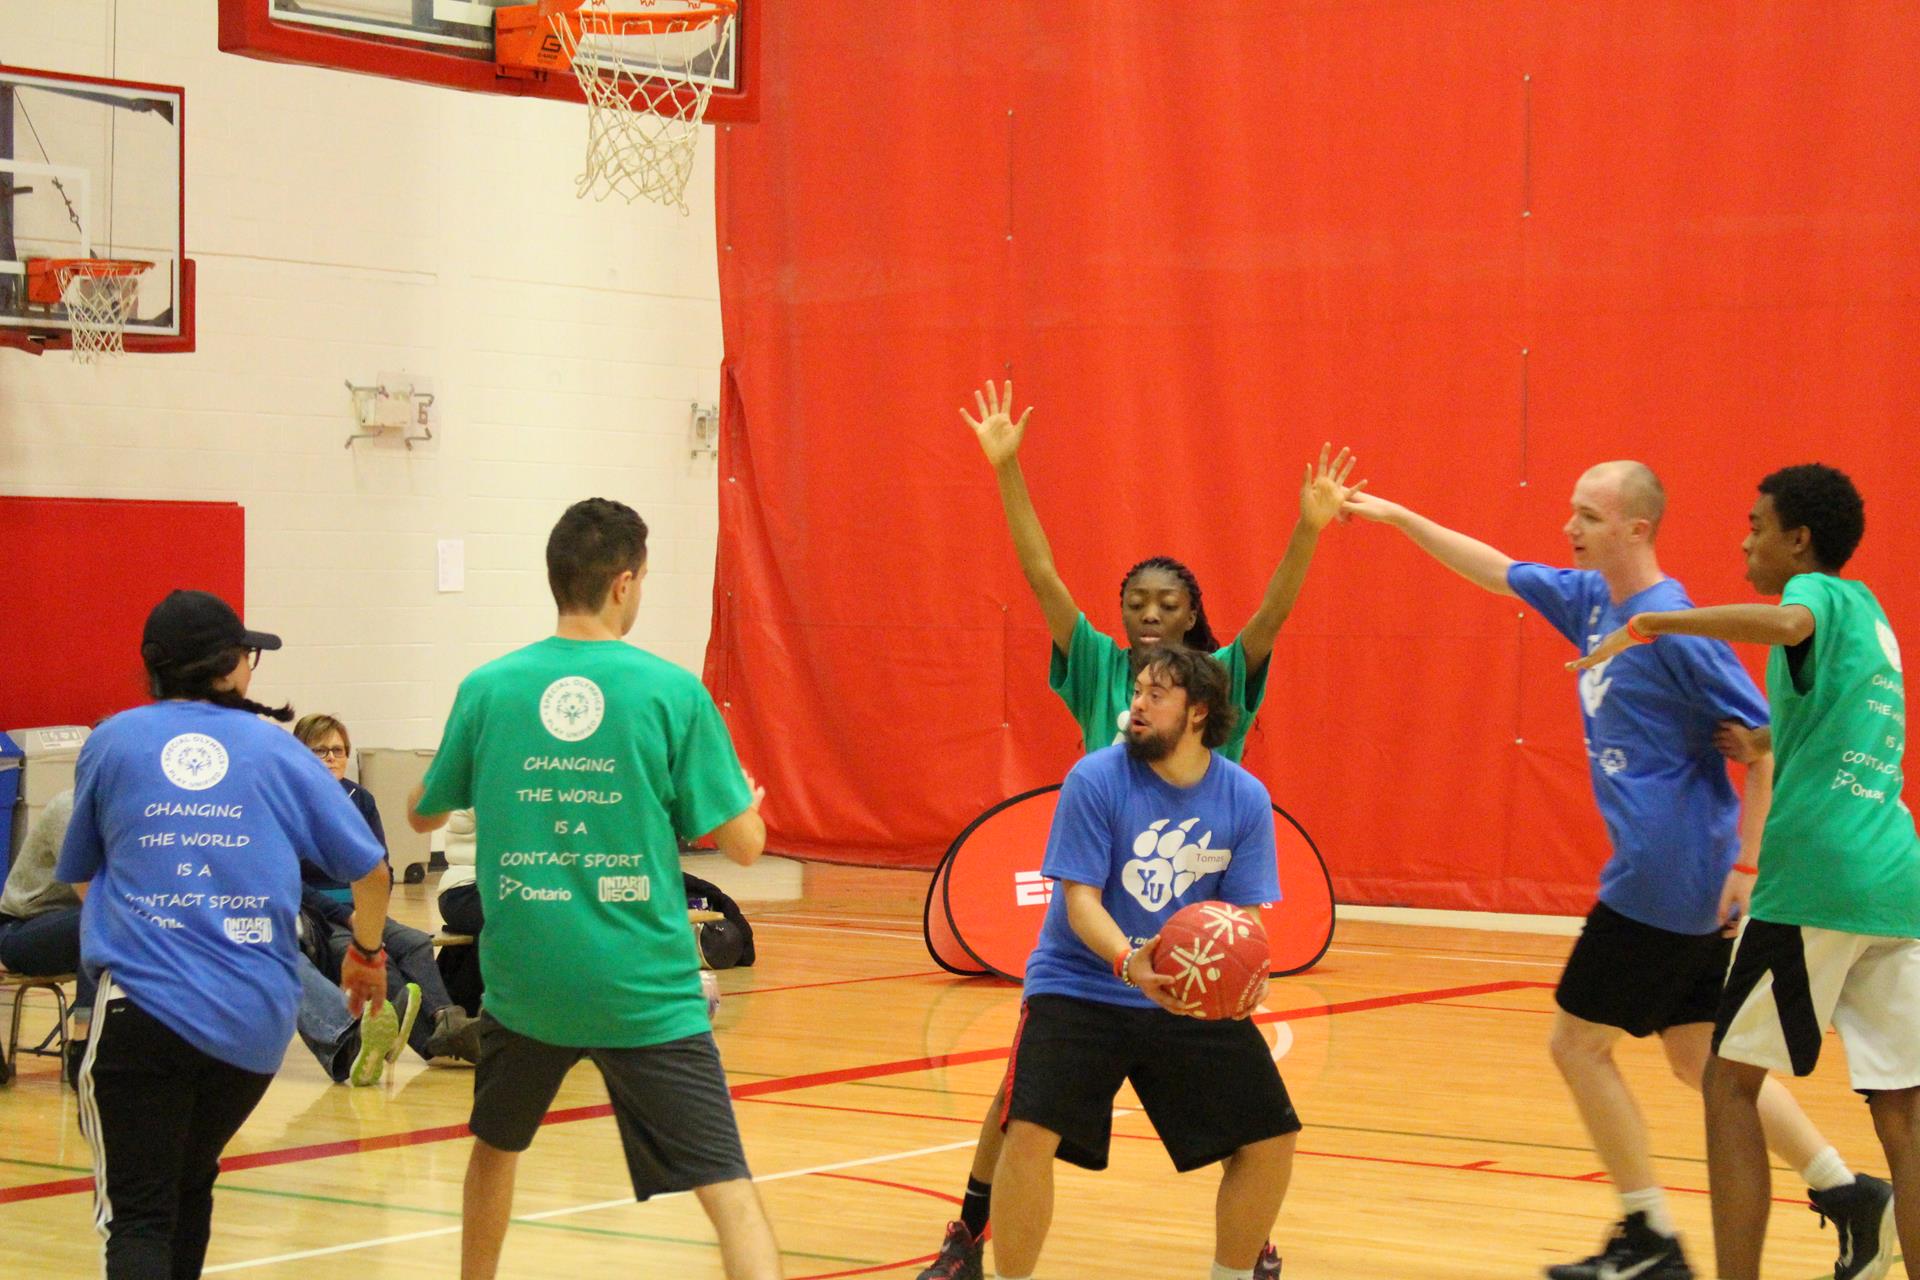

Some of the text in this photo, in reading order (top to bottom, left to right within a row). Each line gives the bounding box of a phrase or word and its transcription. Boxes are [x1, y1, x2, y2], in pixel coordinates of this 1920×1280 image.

[1866, 699, 1892, 716] THE
[523, 756, 616, 774] CHANGING
[516, 788, 623, 804] THE WORLD
[144, 802, 243, 819] CHANGING
[554, 820, 588, 835] IS A
[138, 832, 250, 848] THE WORLD
[500, 851, 643, 868] CONTACT SPORT
[1196, 853, 1225, 863] Tomas
[177, 863, 212, 877] IS A
[520, 887, 572, 901] Ontario
[1137, 868, 1165, 904] YU
[208, 895, 270, 909] SPORT
